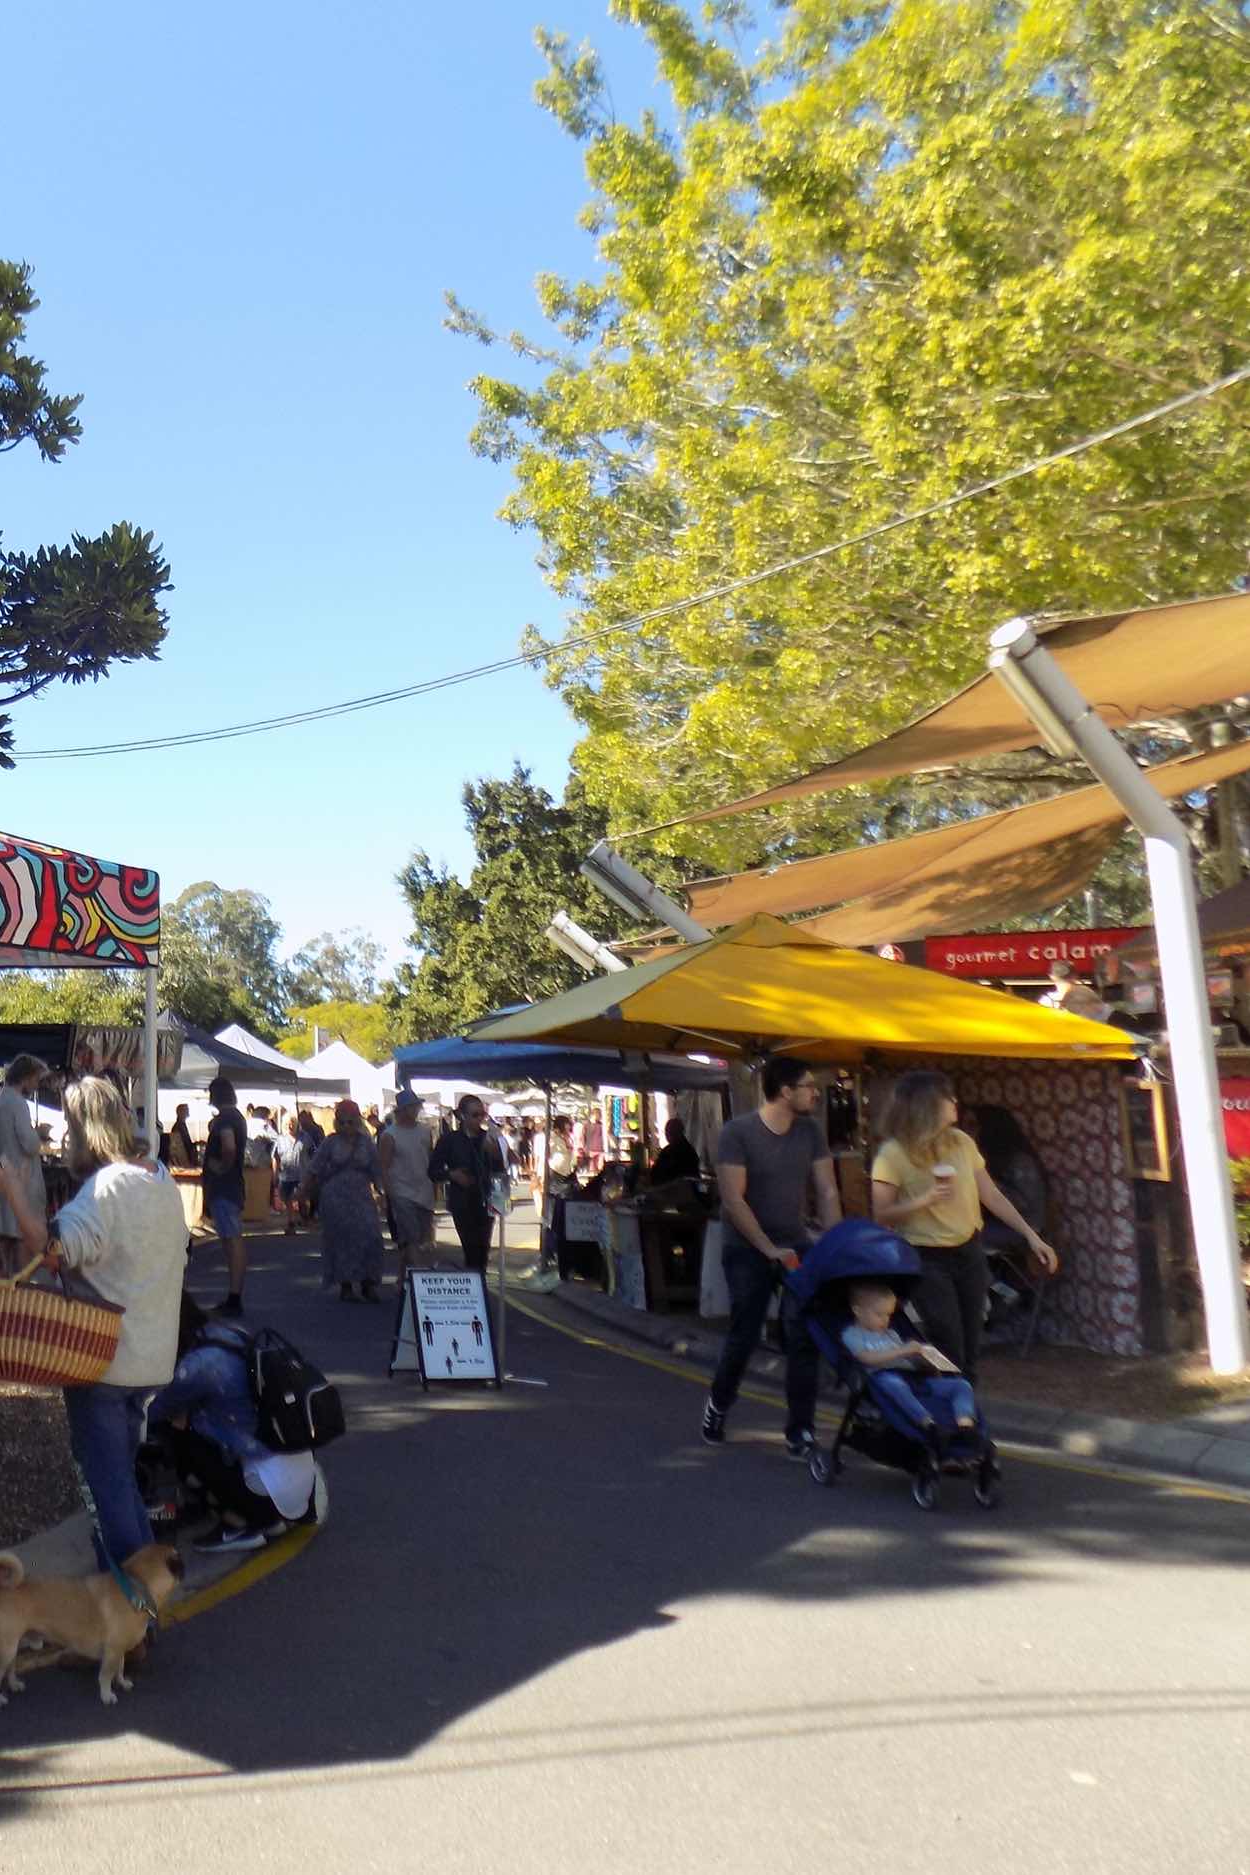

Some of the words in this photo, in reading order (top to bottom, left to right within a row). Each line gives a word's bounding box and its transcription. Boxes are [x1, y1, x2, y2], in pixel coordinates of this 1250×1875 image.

[946, 947, 1015, 971] gourmet
[1028, 942, 1111, 961] calam
[422, 1278, 445, 1286] KEEP
[447, 1278, 472, 1286] YOUR
[427, 1287, 471, 1296] DISTANCE
